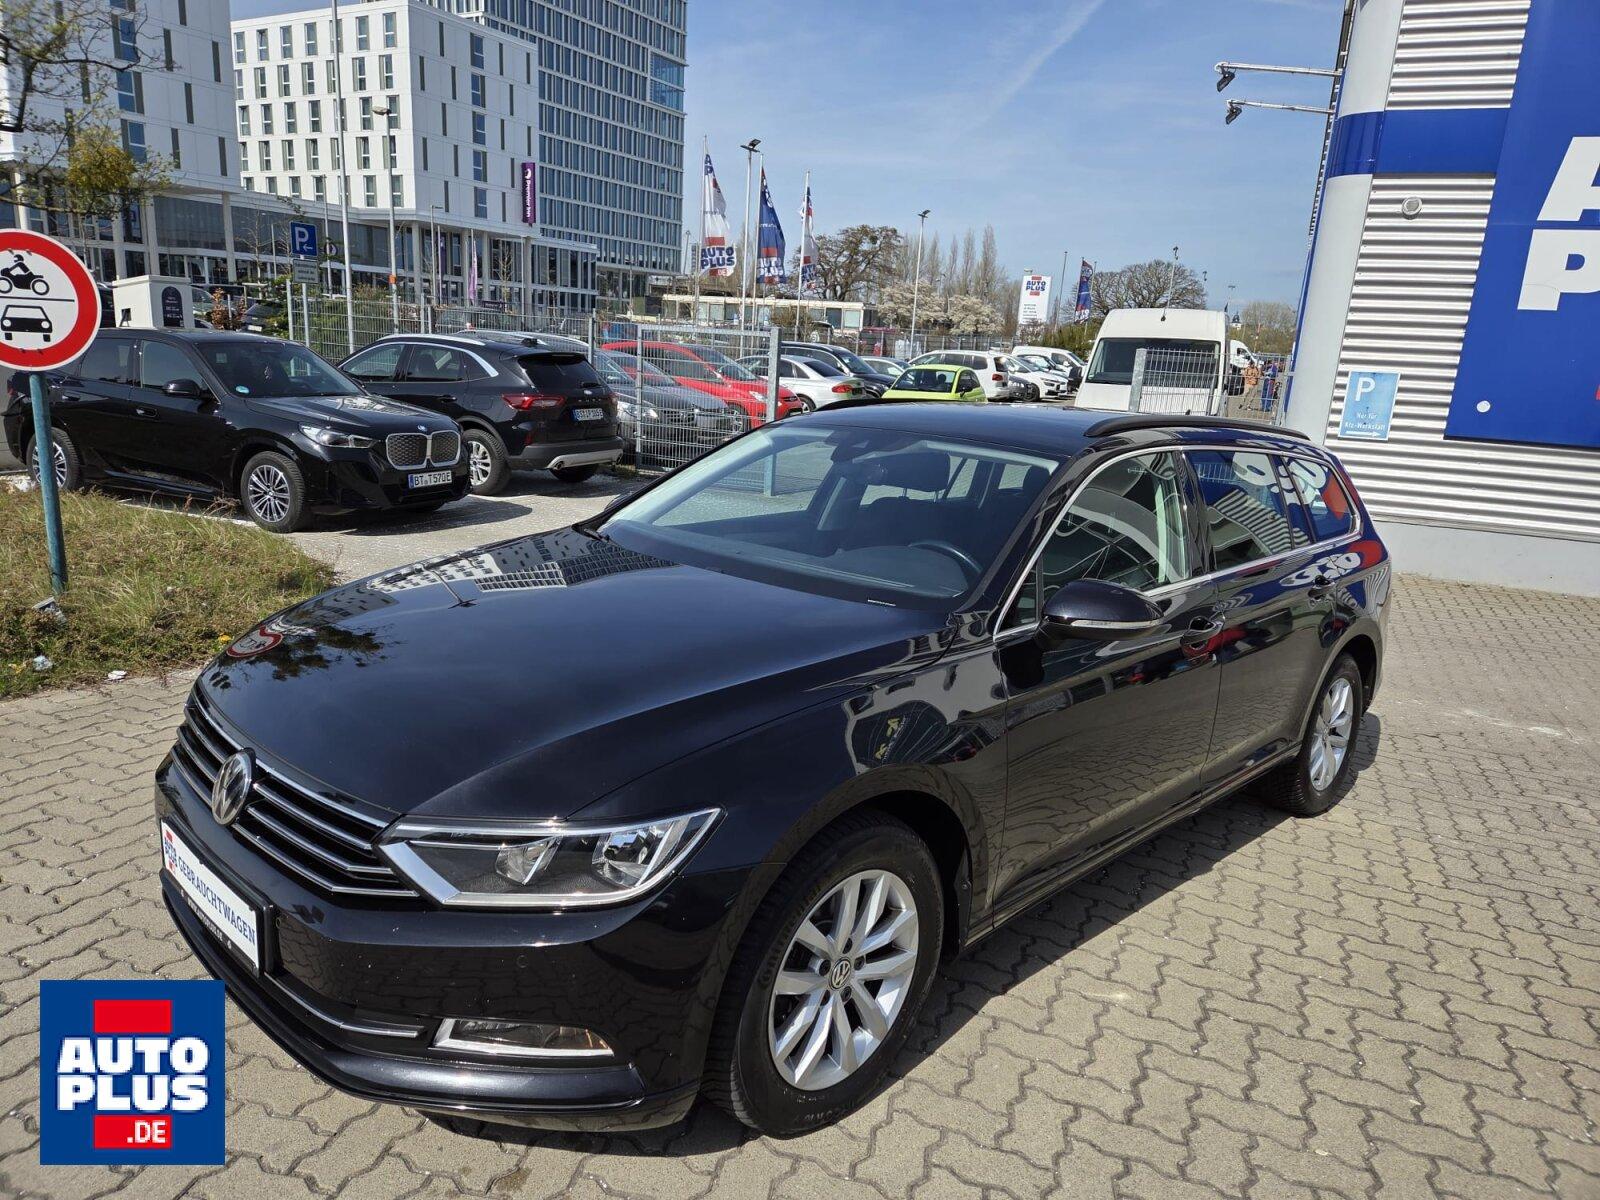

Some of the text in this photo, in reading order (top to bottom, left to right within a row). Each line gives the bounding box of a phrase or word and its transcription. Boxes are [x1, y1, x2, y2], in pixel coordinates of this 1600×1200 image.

[295, 226, 309, 251] P
[701, 246, 735, 258] AUTO
[701, 257, 736, 269] PLUS
[1356, 377, 1376, 402] P
[178, 855, 256, 946] GEBRAUCHTWAGEN
